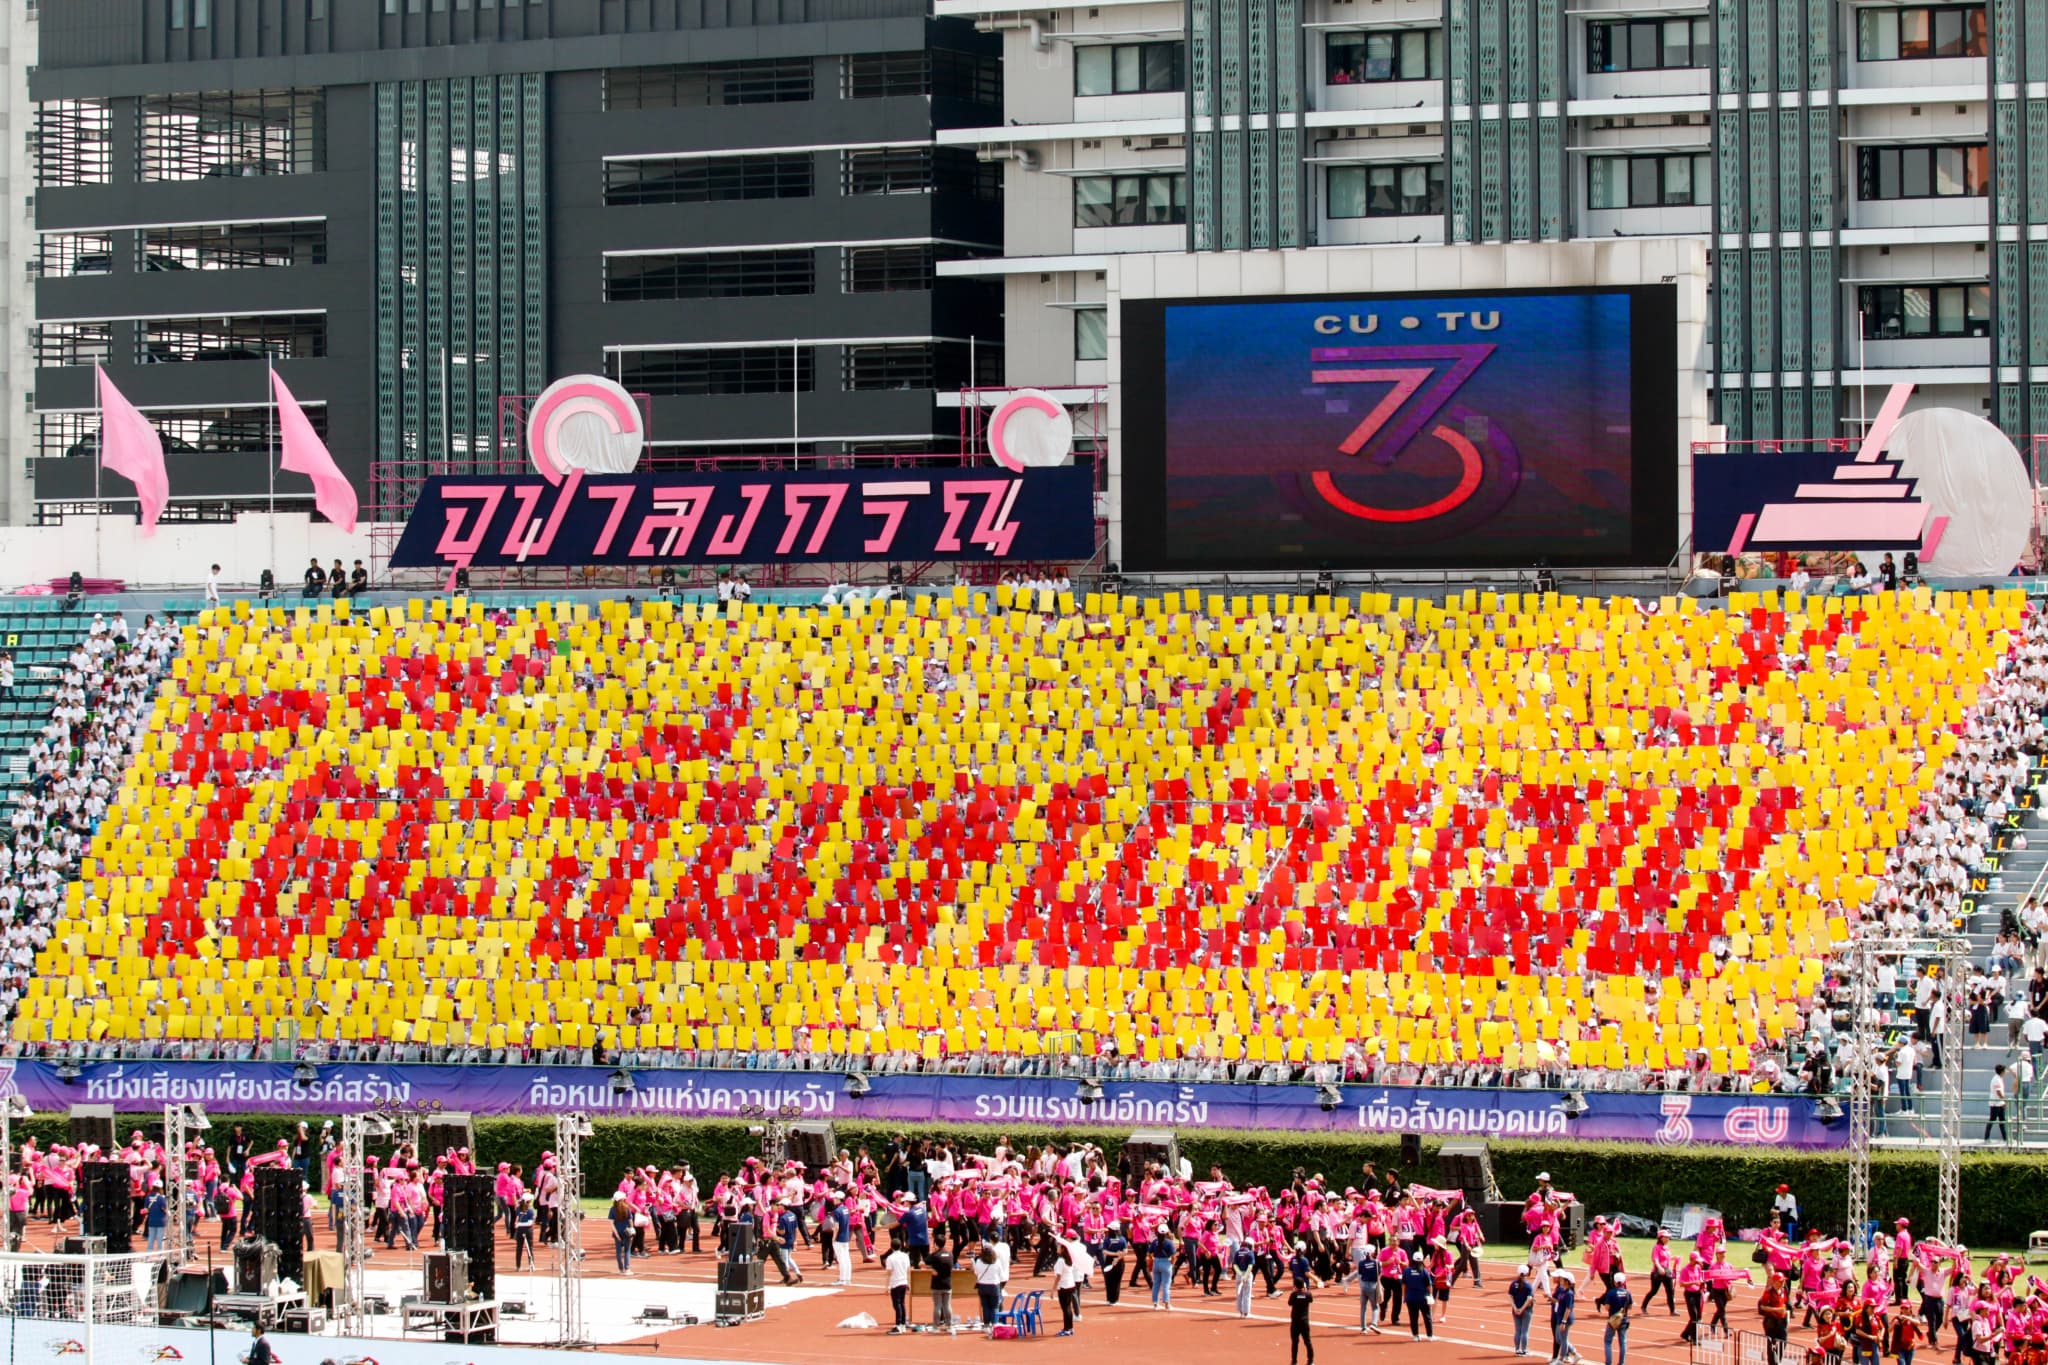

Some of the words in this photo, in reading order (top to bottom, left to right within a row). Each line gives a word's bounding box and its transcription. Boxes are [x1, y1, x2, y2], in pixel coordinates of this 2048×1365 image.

[1314, 313, 1378, 334] CU
[1437, 310, 1501, 332] TU
[2008, 814, 2020, 828] K
[1971, 878, 1986, 891] N
[1927, 964, 1939, 978] R
[975, 1086, 1209, 1124] รวมแรงกนอีกครั้ง
[1723, 1105, 1790, 1143] CU
